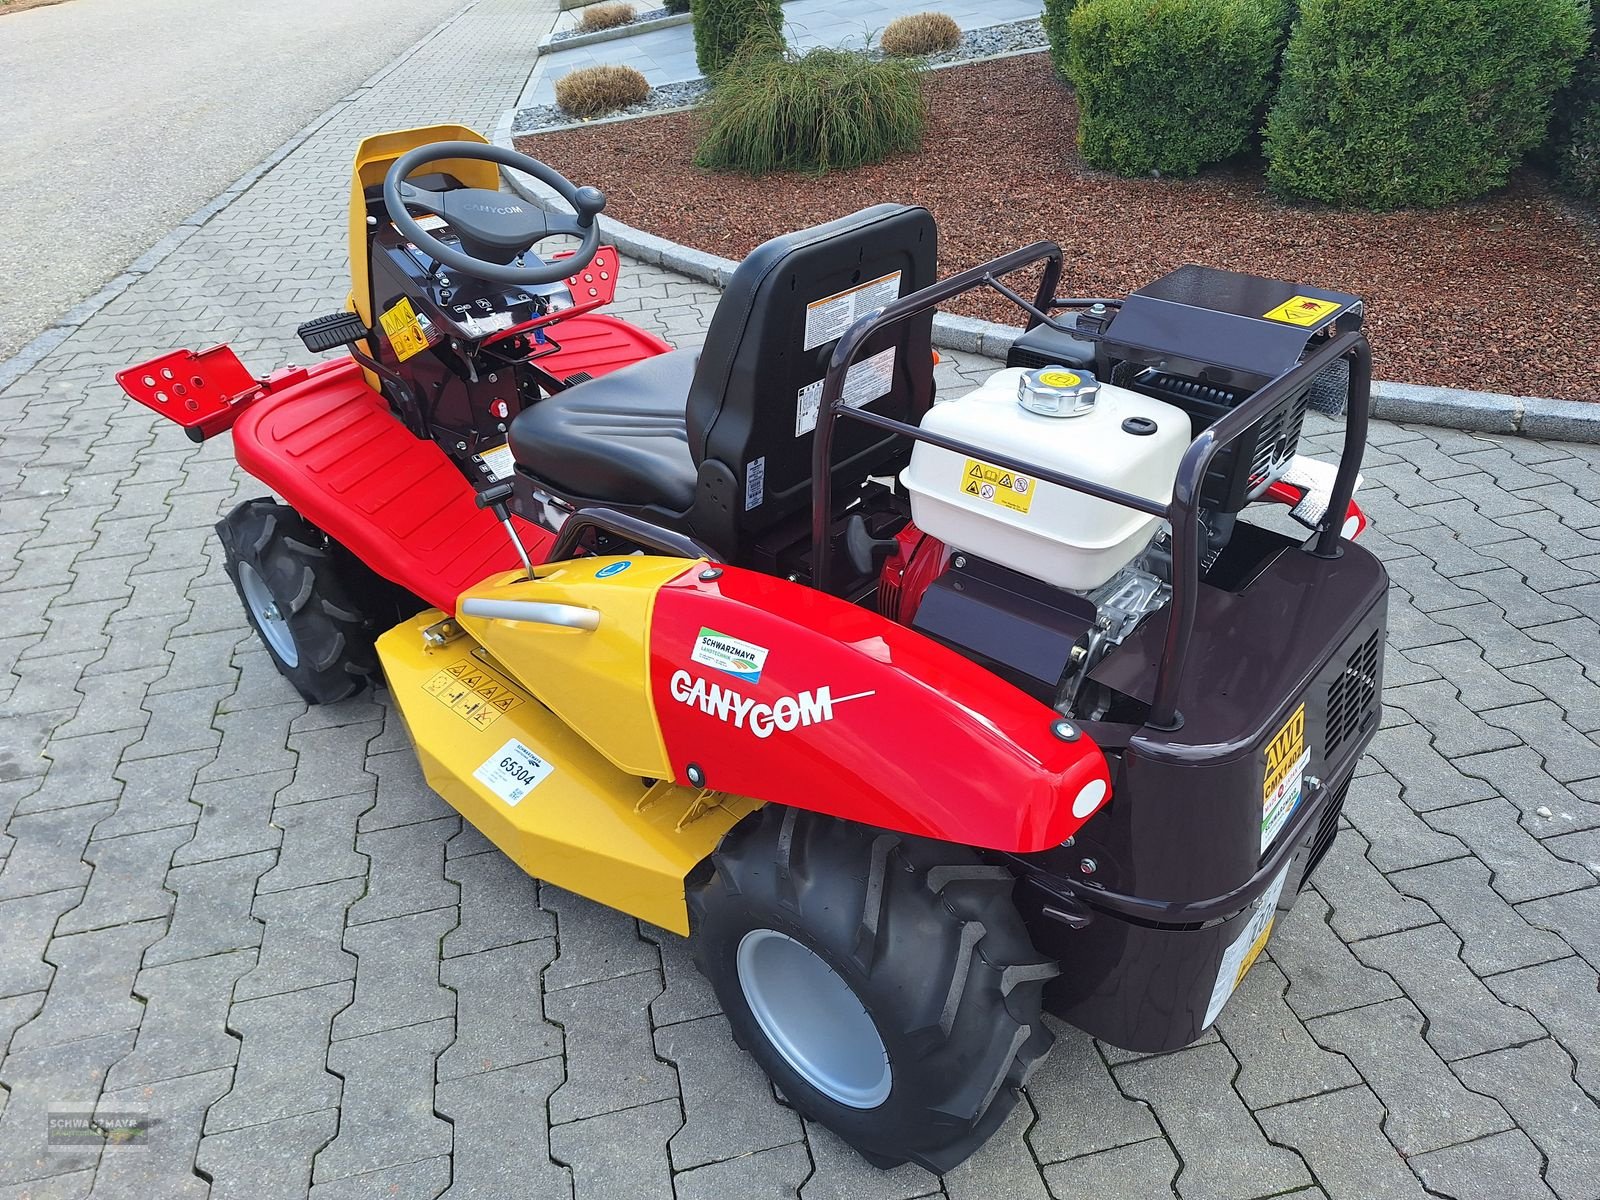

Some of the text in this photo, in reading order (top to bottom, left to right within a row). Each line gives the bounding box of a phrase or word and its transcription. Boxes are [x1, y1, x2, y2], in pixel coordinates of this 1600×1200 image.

[463, 203, 523, 215] CANYCOM
[702, 636, 756, 661] SCHWARZMAYR
[670, 669, 836, 738] CANYCOM
[1264, 709, 1305, 781] AWD
[500, 756, 536, 786] 65304
